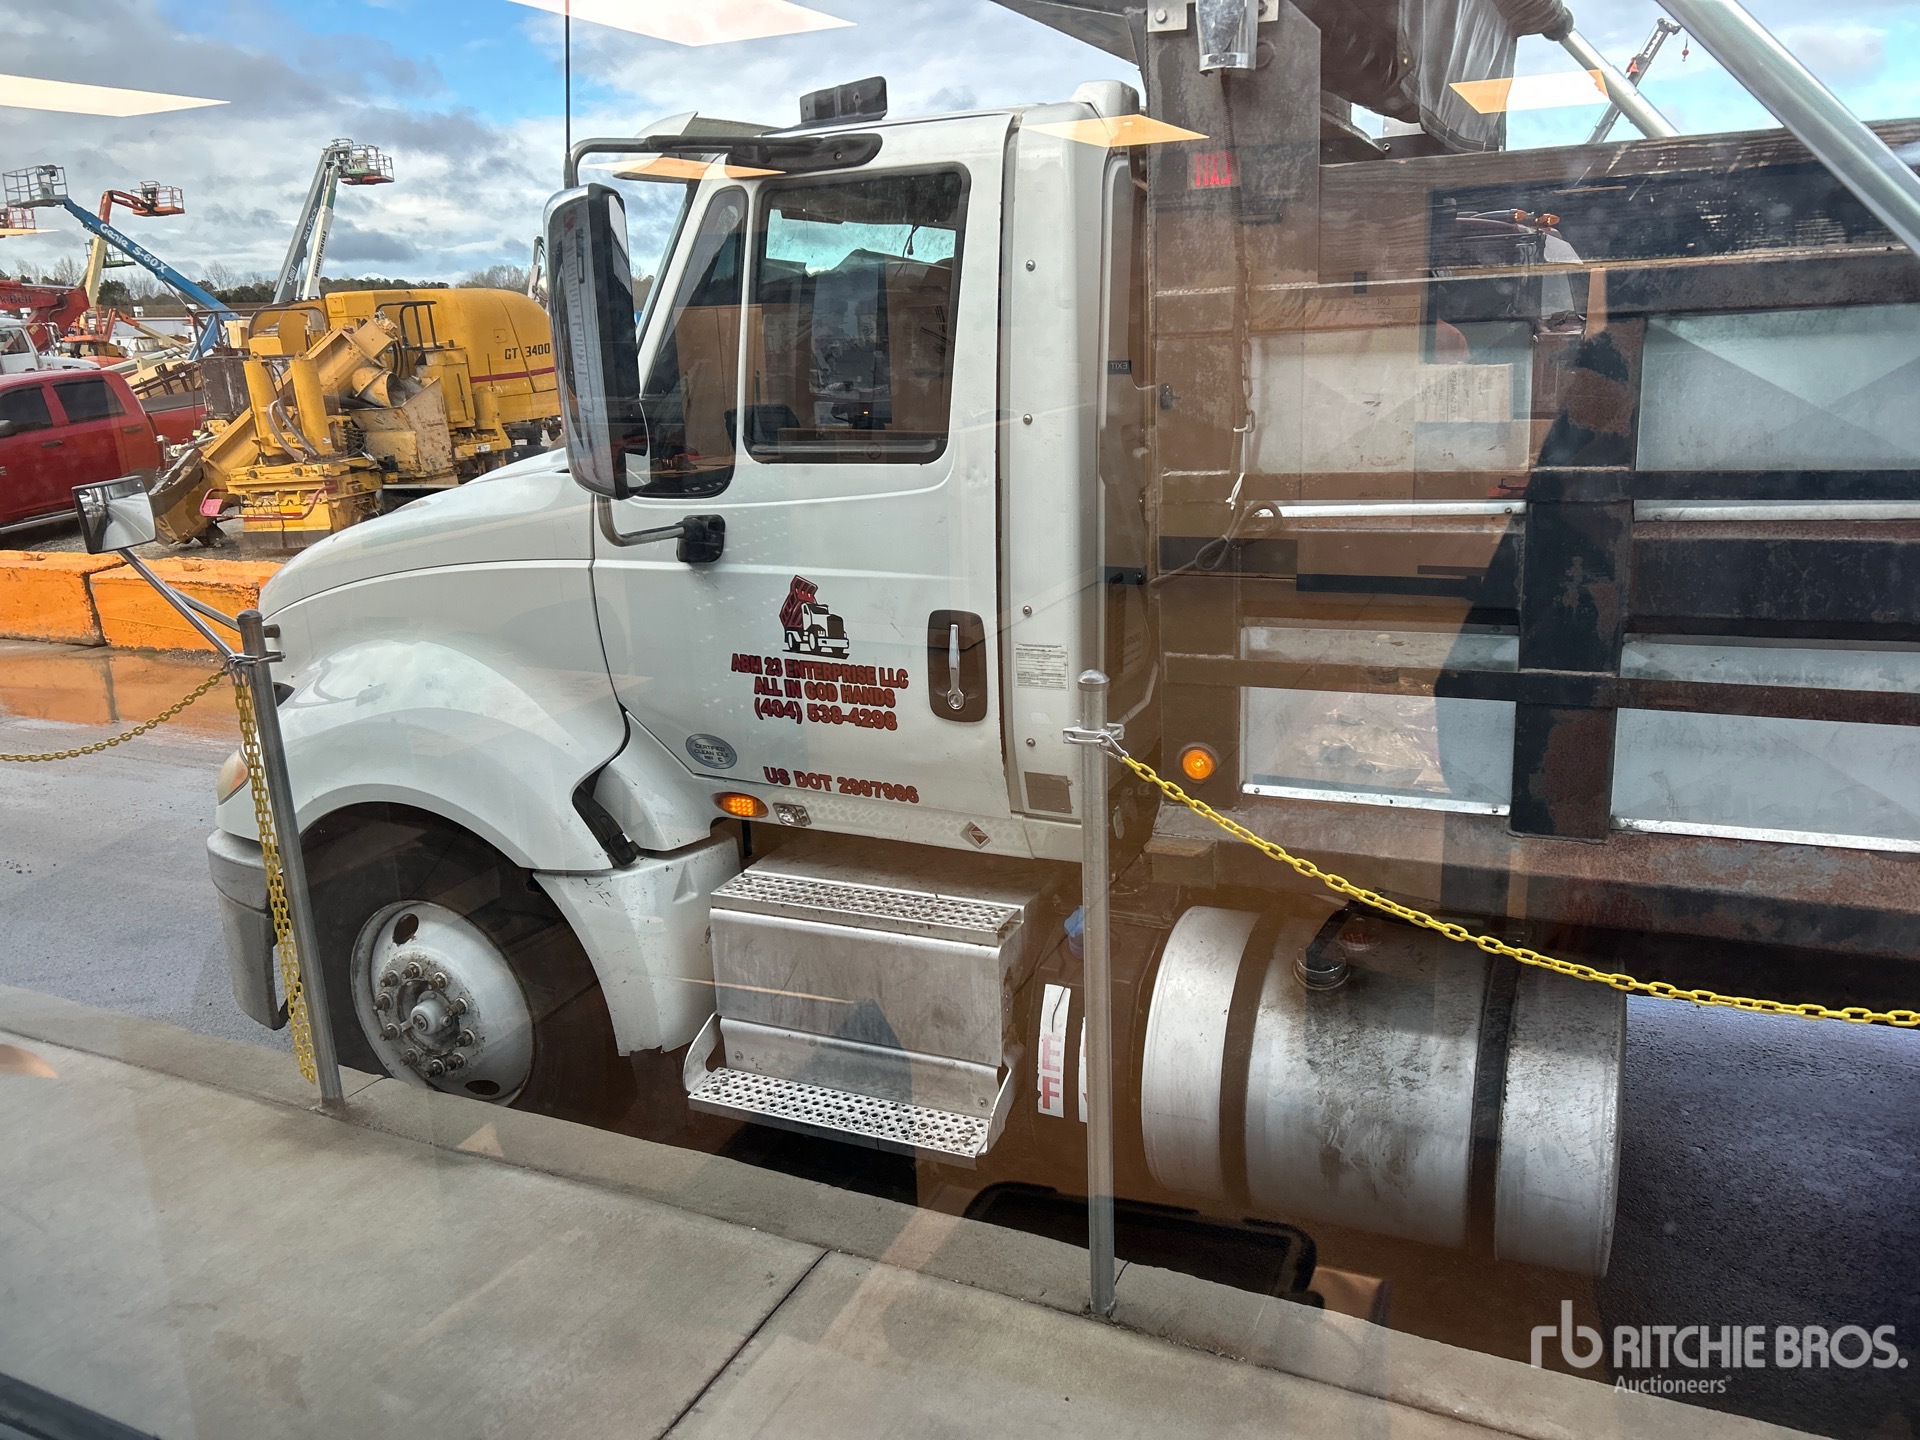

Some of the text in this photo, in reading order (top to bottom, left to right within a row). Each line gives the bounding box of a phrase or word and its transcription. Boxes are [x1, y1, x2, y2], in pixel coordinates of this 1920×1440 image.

[100, 223, 129, 248] Genie
[303, 207, 318, 240] SKYJACK
[505, 343, 551, 360] GT 3400
[731, 653, 910, 689] ABM 23 ENTERPRISE LLC
[754, 676, 896, 708] ALL IN GOD HANDS
[754, 697, 898, 731] (404) 538-4298
[763, 766, 791, 786] US
[793, 770, 832, 792] DOT
